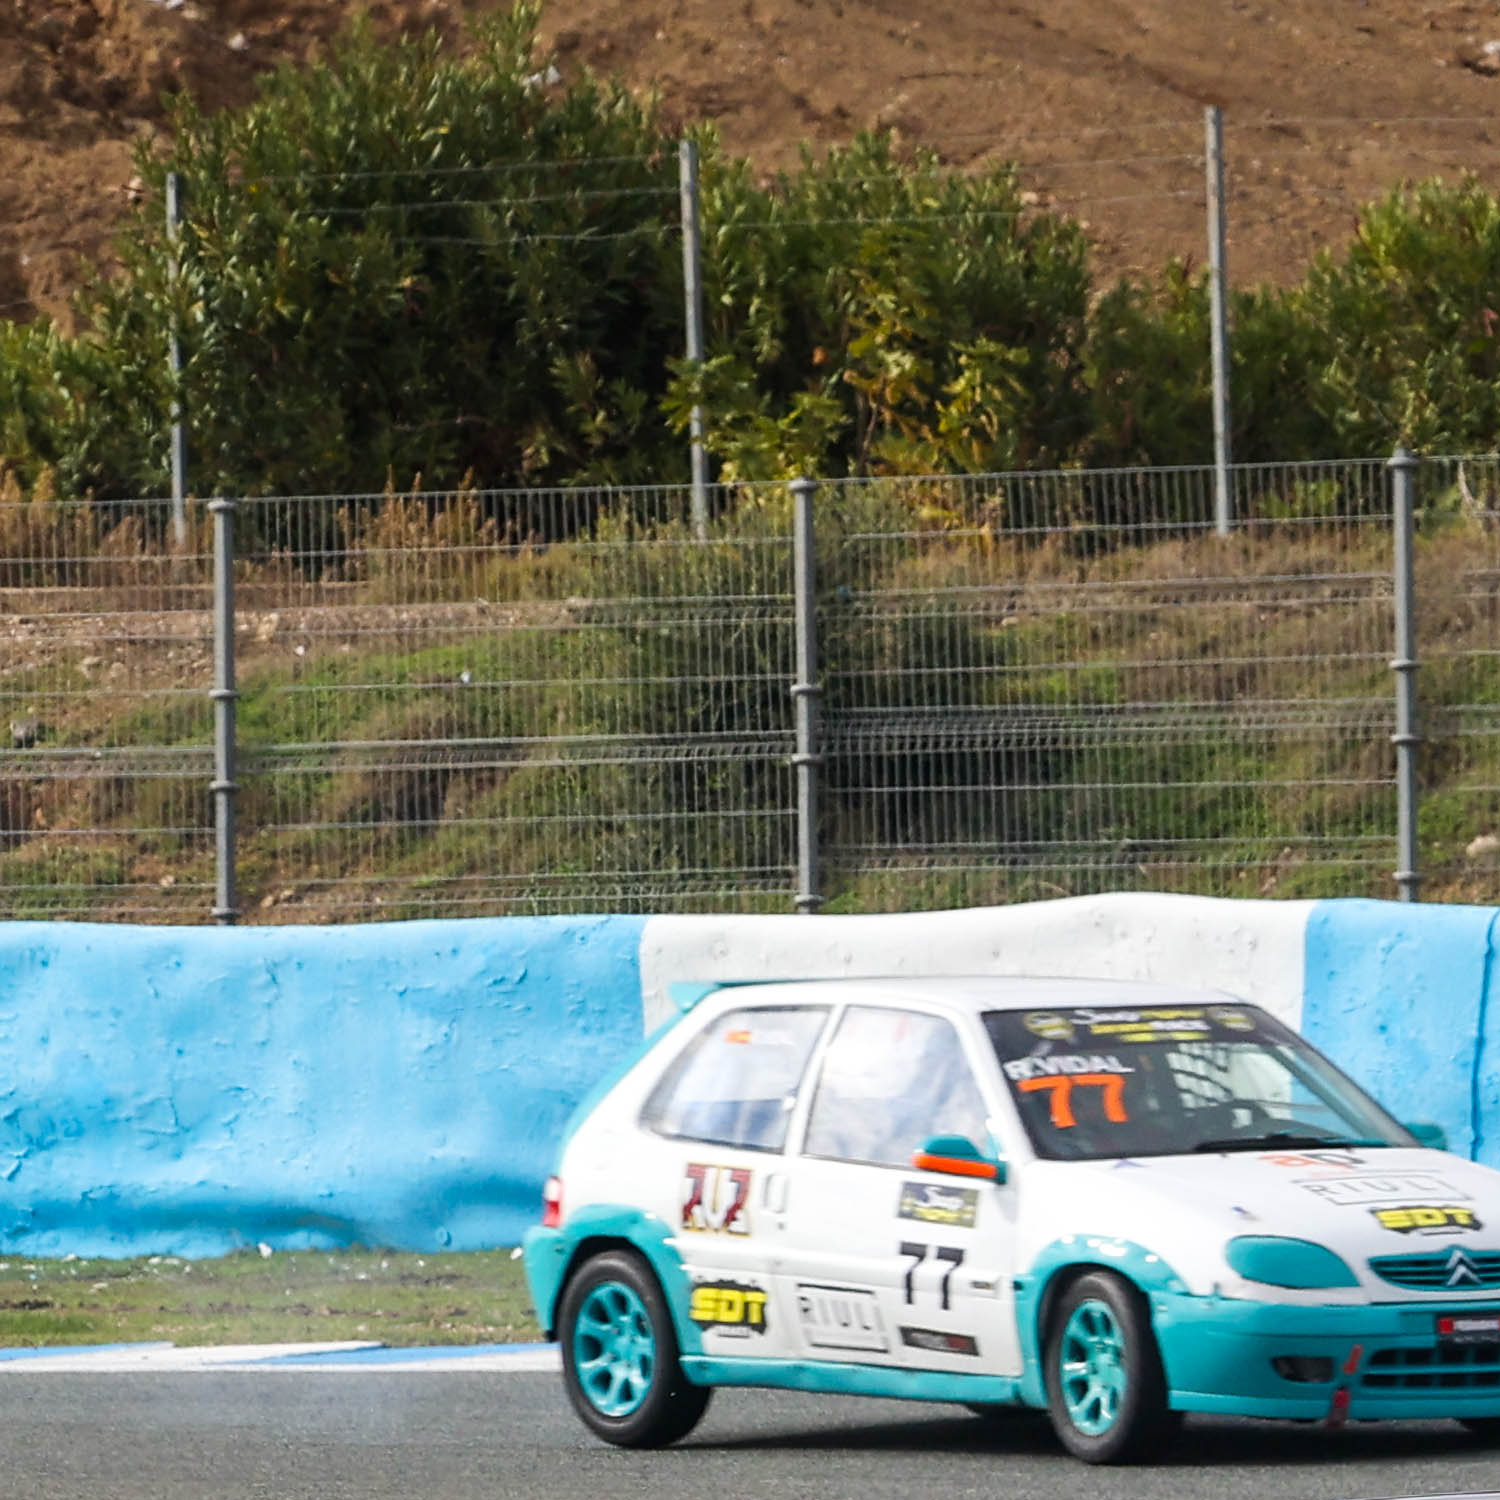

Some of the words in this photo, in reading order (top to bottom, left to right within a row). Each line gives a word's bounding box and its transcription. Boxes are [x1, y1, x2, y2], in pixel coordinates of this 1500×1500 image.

[1017, 1074, 1128, 1128] 77
[900, 1241, 964, 1310] 77
[689, 1287, 768, 1324] SDT
